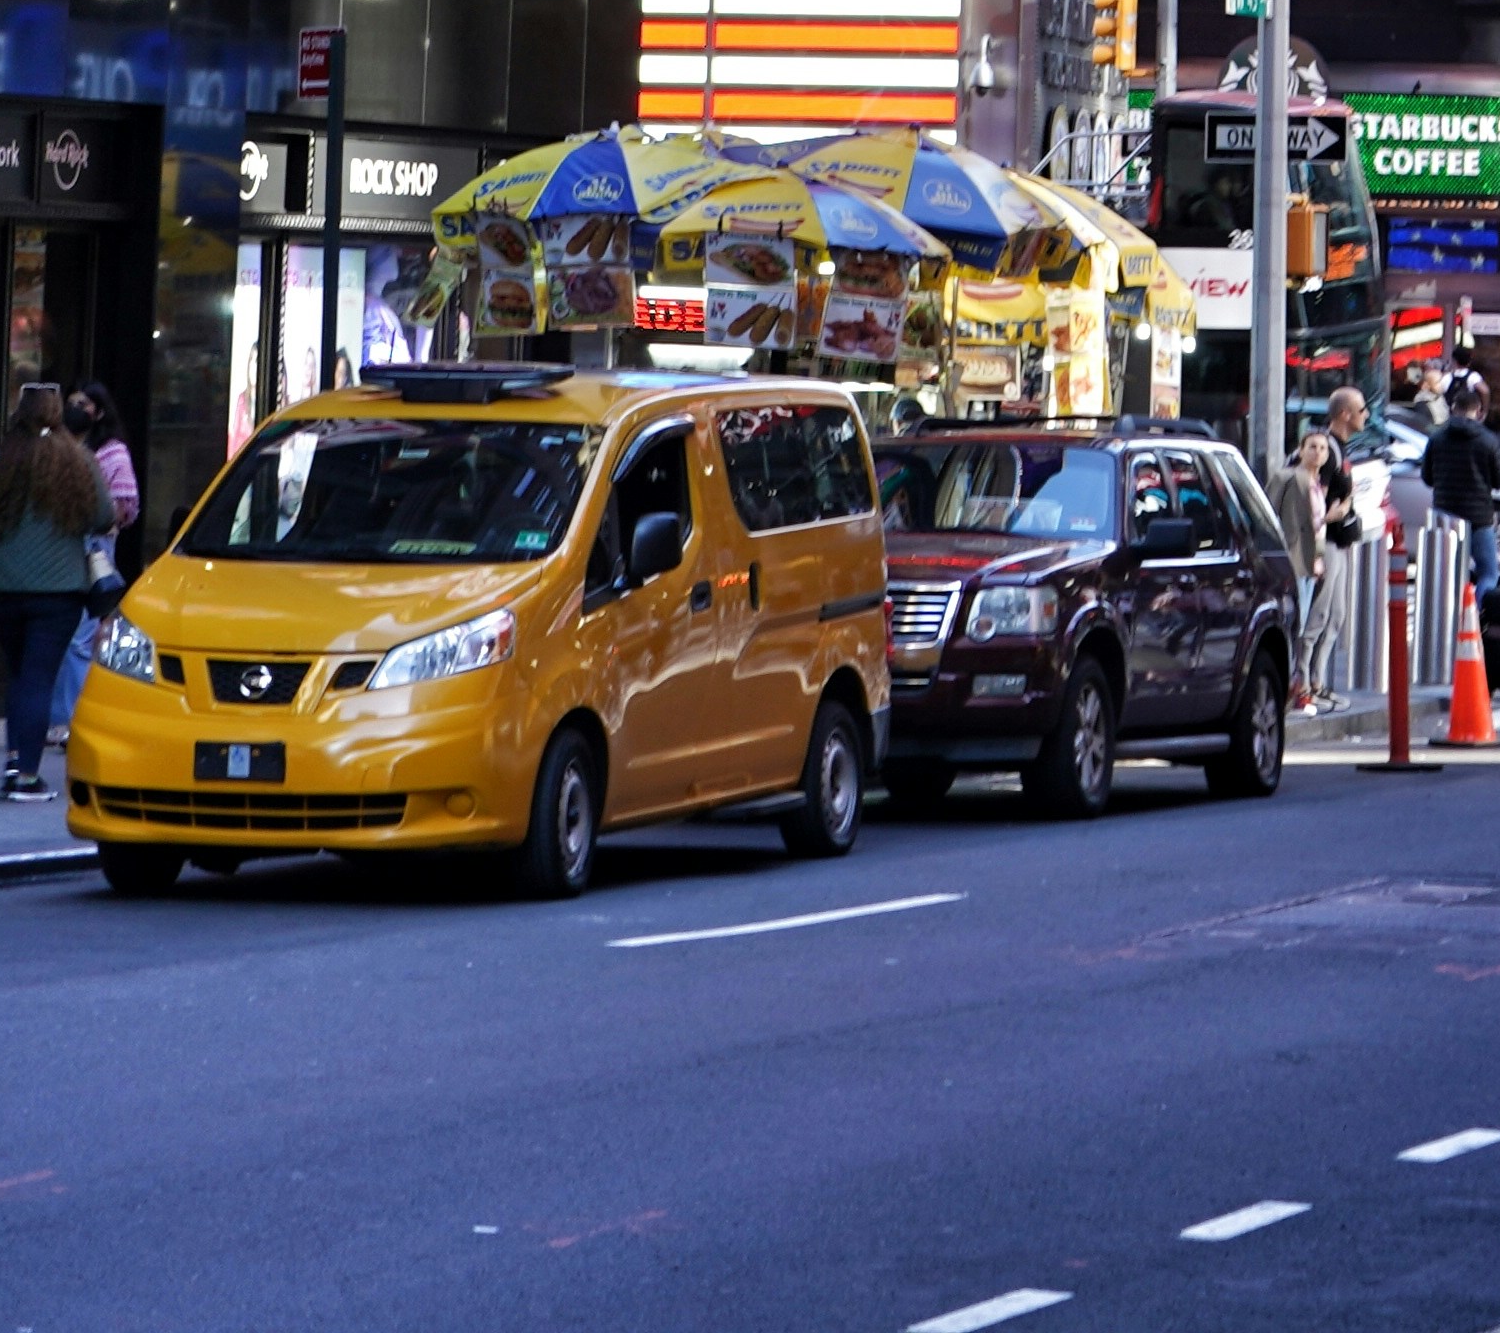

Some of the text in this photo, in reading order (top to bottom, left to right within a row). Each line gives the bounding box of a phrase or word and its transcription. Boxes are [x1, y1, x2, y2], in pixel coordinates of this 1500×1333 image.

[1226, 127, 1254, 148] ON
[349, 156, 439, 198] ROCK SHOP
[1373, 147, 1481, 177] COFFEE
